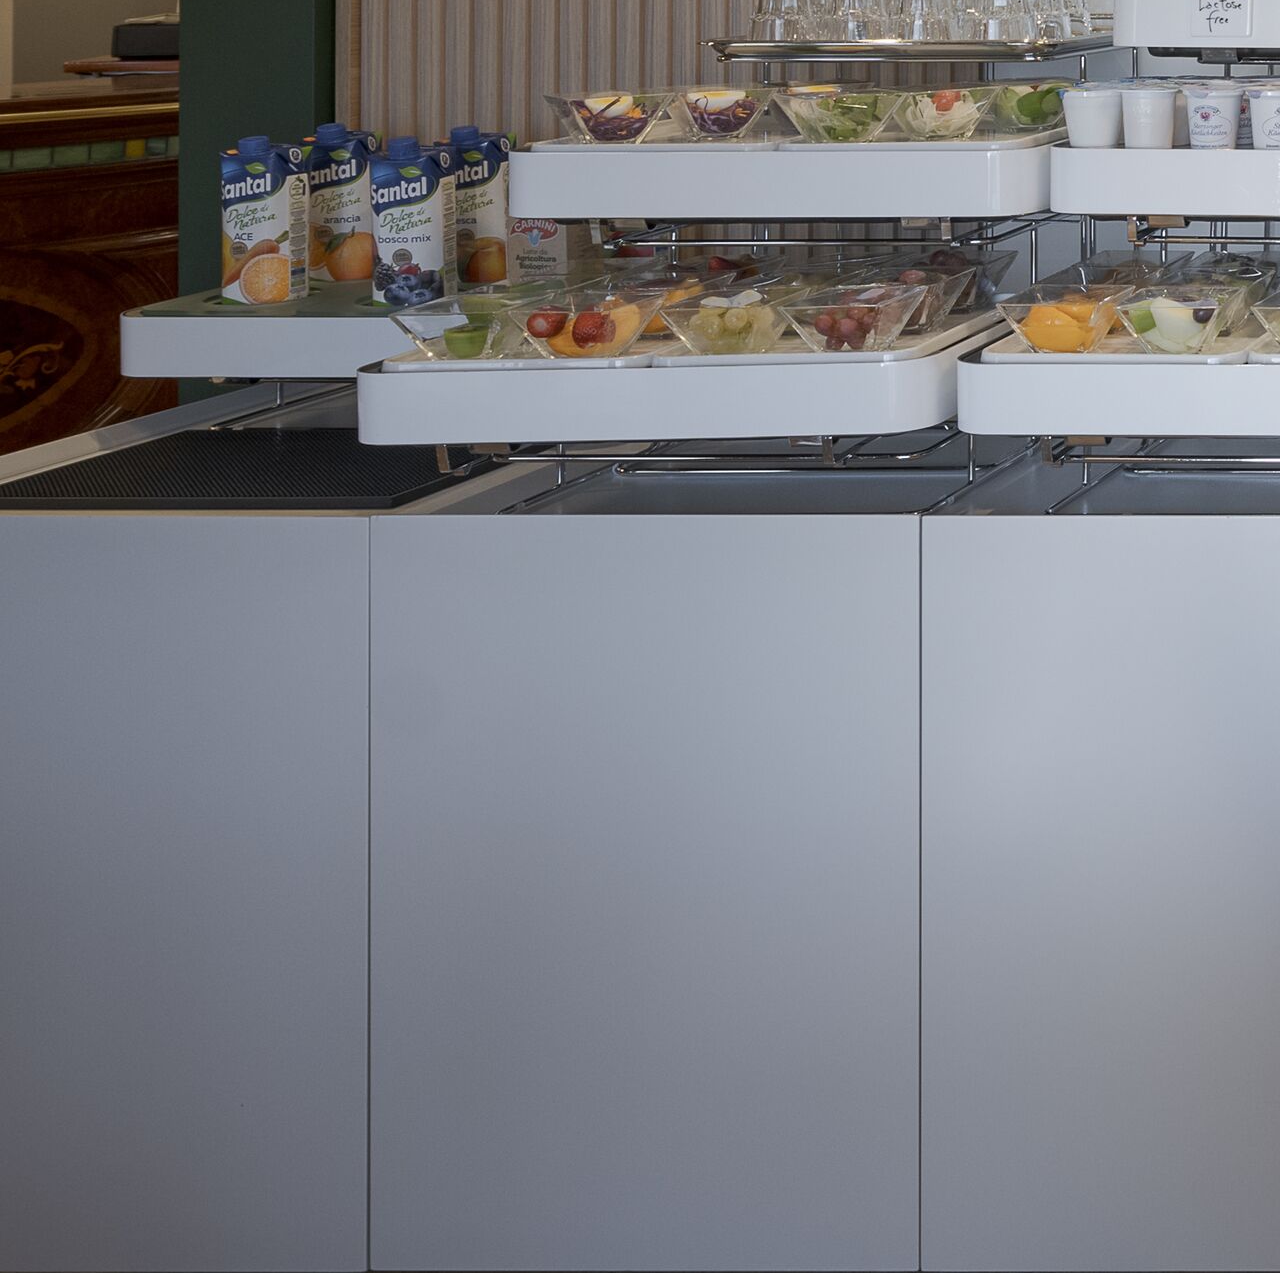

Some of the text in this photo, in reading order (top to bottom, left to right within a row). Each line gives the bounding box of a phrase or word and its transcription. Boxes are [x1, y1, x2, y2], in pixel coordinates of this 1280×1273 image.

[310, 159, 357, 185] antal
[456, 160, 489, 184] ntal
[371, 176, 427, 205] Santal
[323, 215, 361, 224] arancia
[456, 217, 477, 225] esca
[514, 219, 556, 232] CARNINI
[234, 232, 254, 241] ACE
[378, 234, 432, 244] bosco mix
